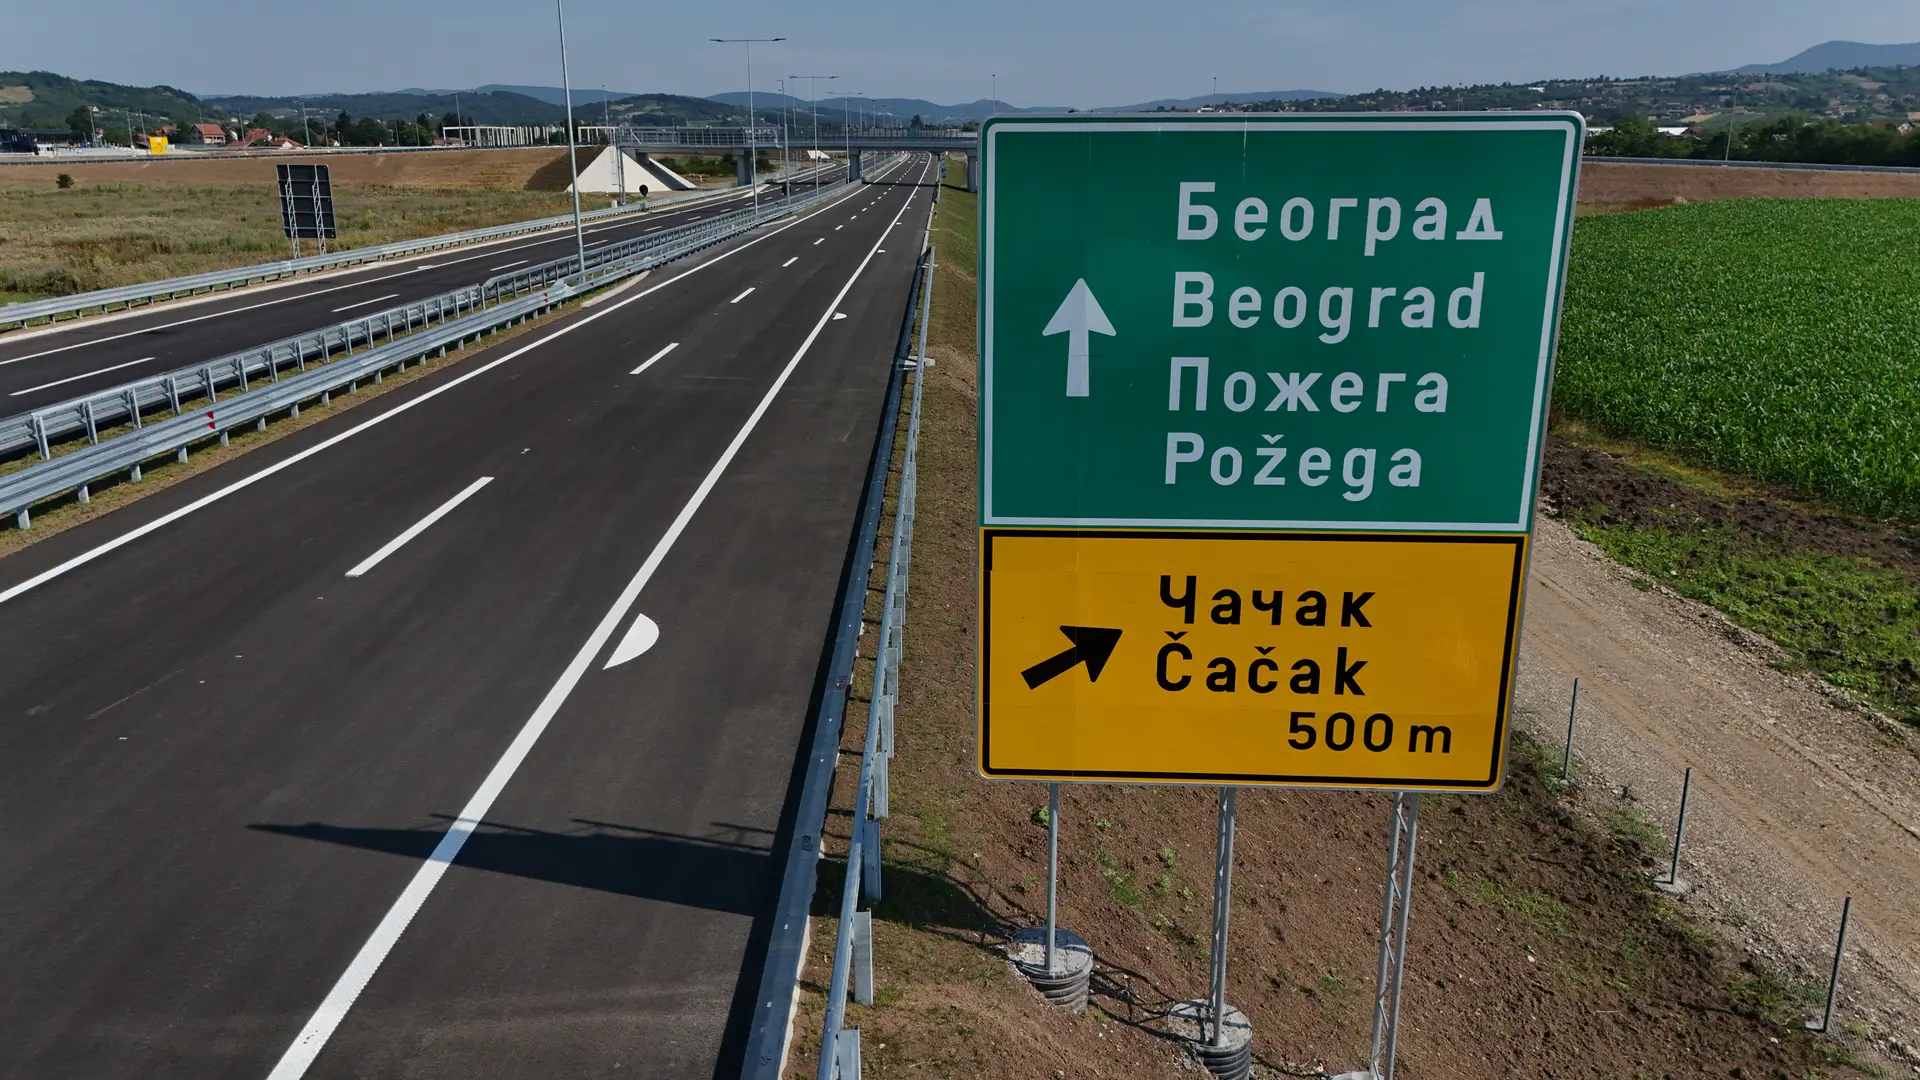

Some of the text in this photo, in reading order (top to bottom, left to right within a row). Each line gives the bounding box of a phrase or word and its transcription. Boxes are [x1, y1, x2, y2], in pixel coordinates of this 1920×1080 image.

[1177, 181, 1504, 257] Београд
[1172, 271, 1486, 344] Beograd
[1168, 356, 1449, 413] Пожега
[1164, 431, 1423, 502] Požega
[1159, 574, 1376, 628] Чачак
[1155, 630, 1368, 696] Čačak
[1287, 711, 1452, 754] 500 m
